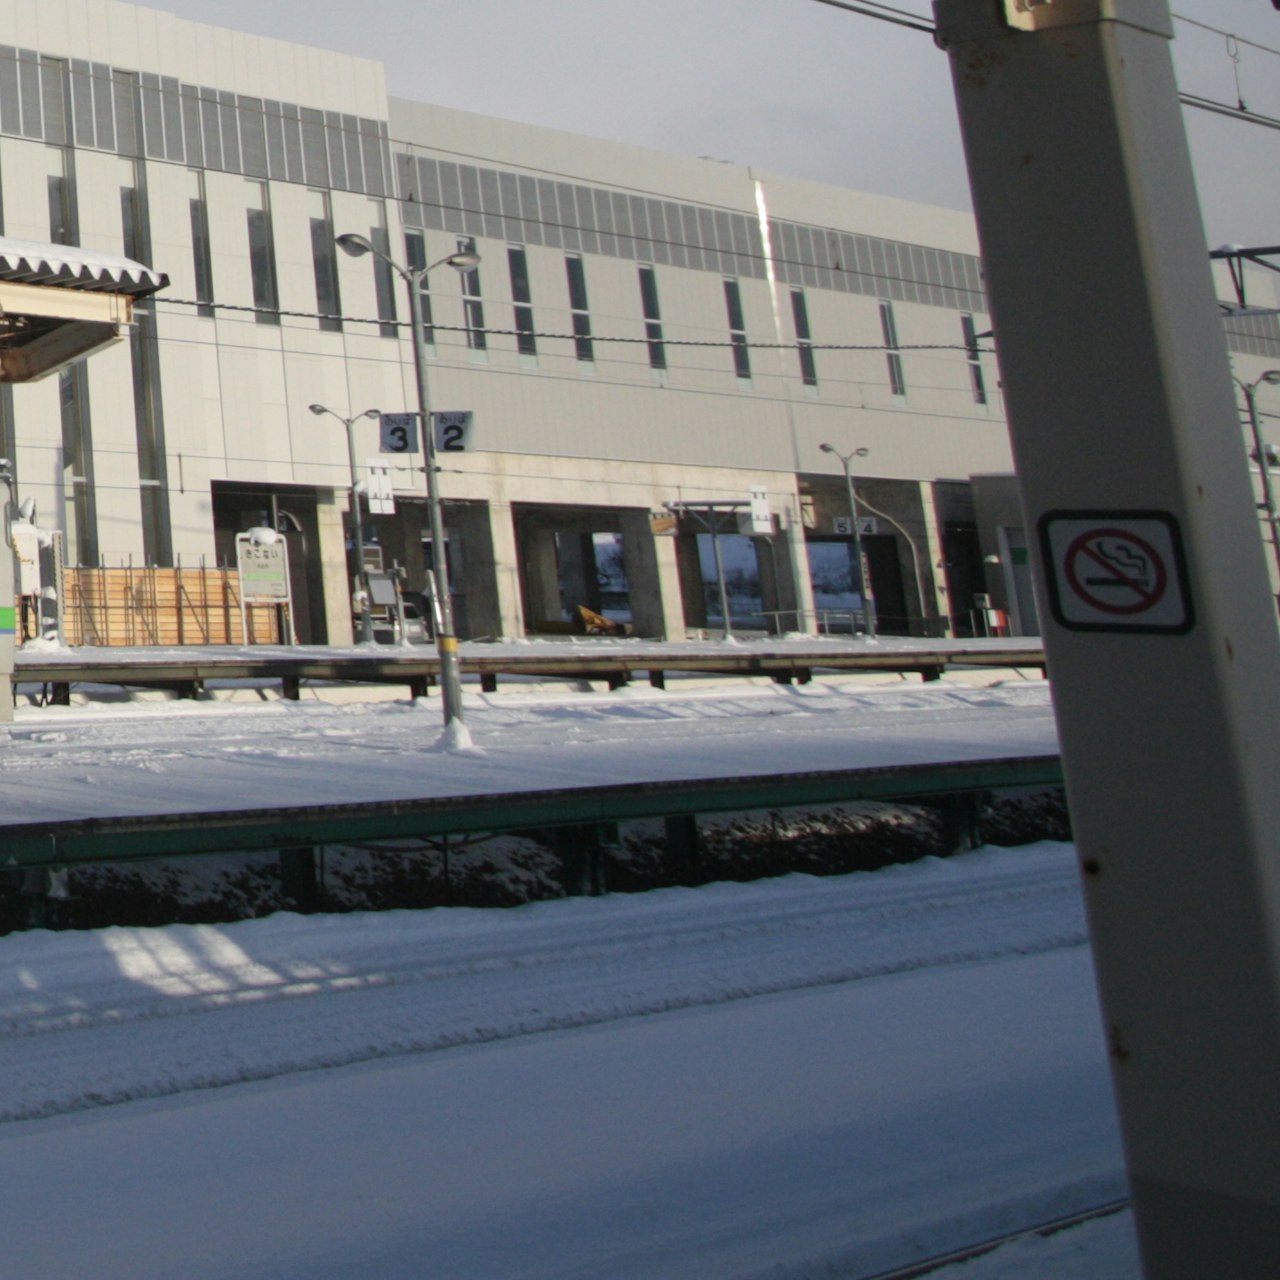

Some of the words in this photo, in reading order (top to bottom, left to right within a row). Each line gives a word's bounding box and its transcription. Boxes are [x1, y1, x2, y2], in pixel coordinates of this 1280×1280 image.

[389, 426, 408, 452] 3
[443, 425, 465, 451] 2
[837, 522, 847, 533] 5
[863, 523, 873, 533] 4
